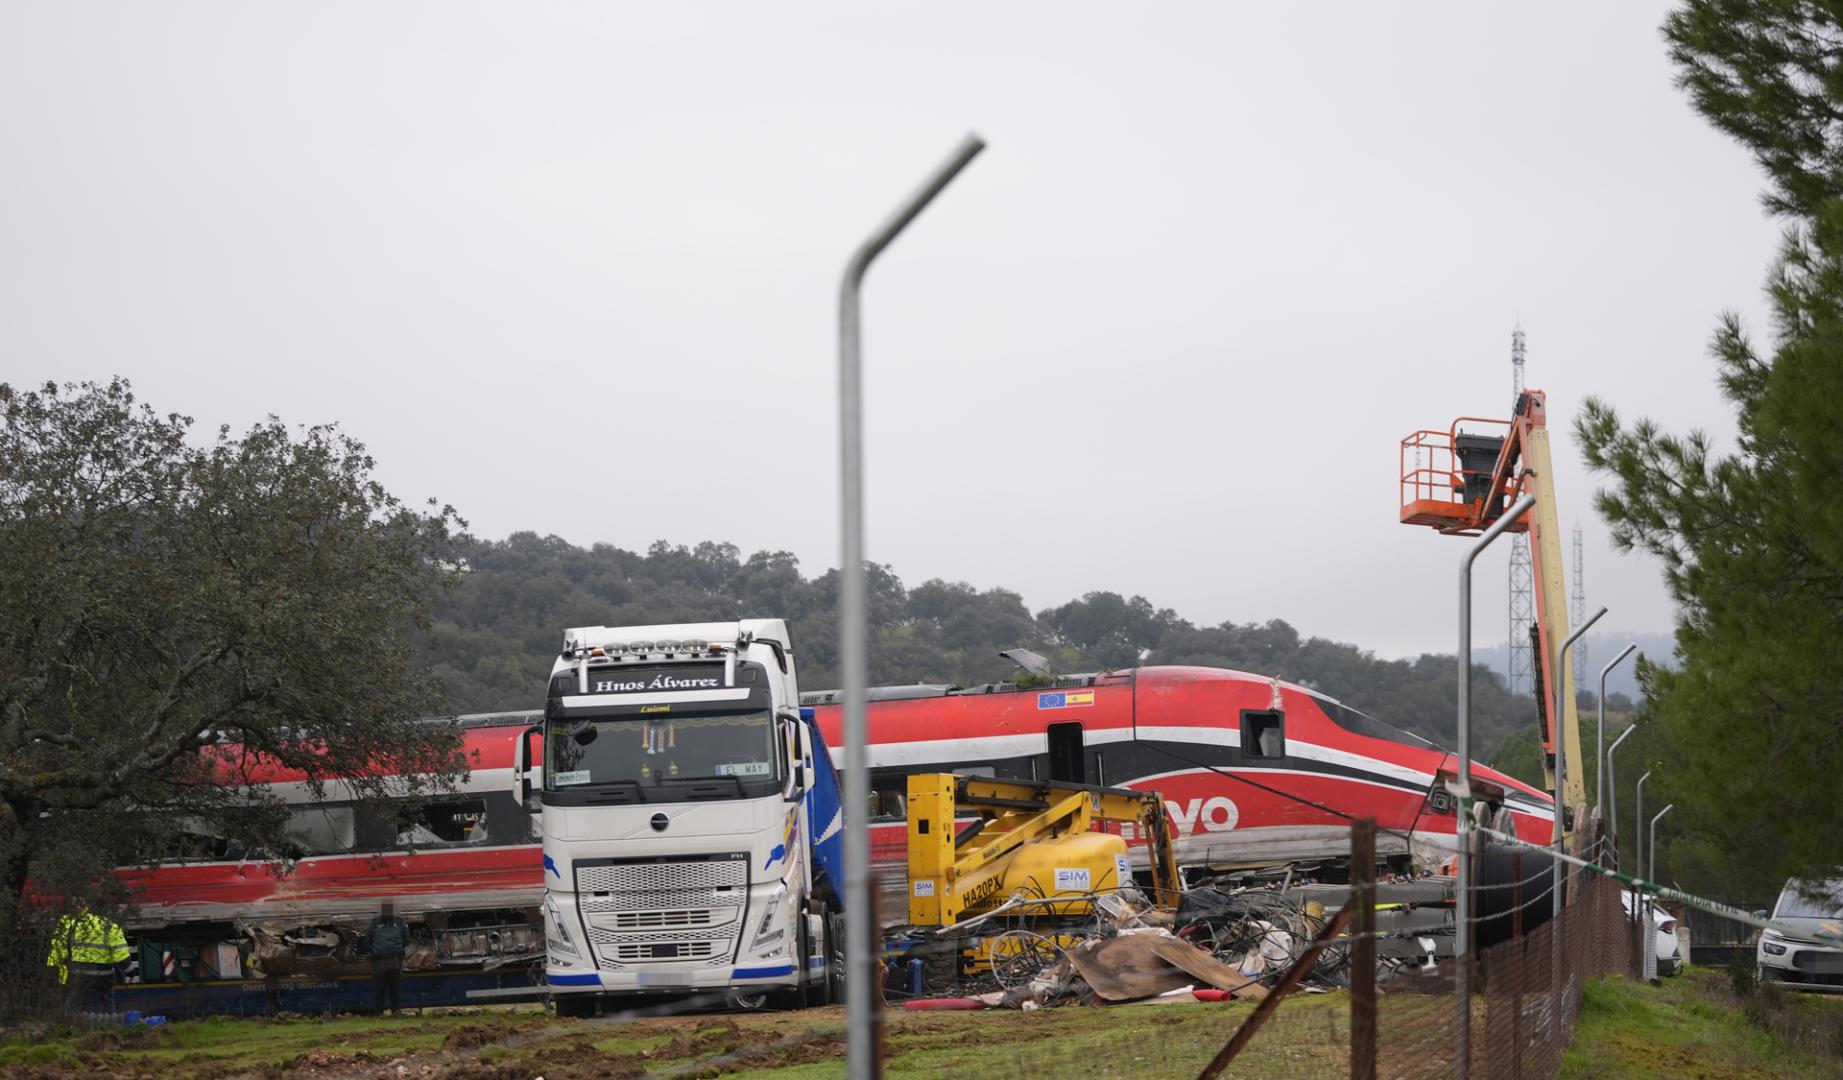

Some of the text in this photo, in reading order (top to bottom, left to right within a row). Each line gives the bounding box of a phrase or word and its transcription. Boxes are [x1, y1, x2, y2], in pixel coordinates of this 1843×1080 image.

[595, 674, 718, 692] Hnos Álvarez
[726, 766, 737, 775] EL
[1058, 871, 1088, 881] SIM
[916, 882, 933, 890] SIM
[962, 873, 1003, 909] HA20PX
